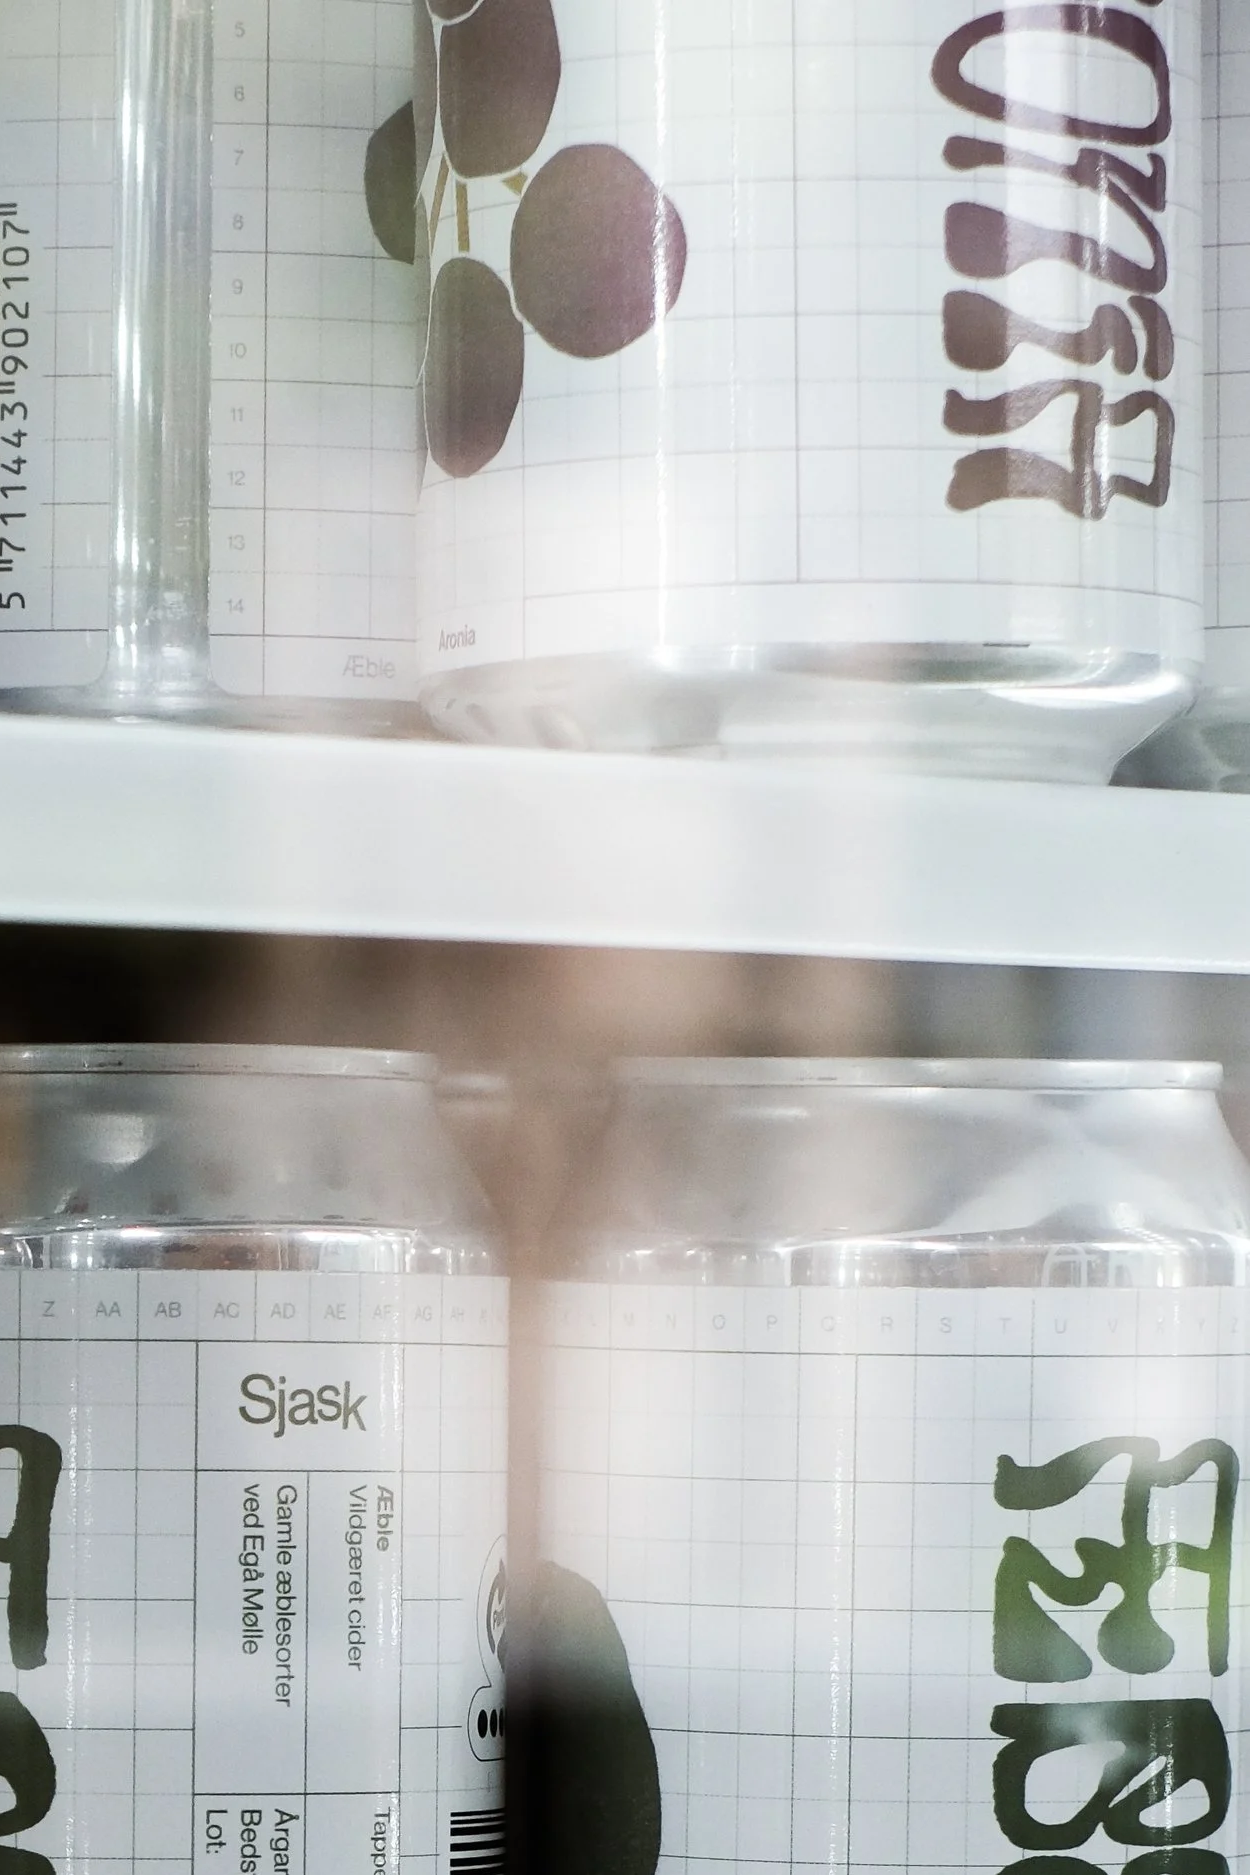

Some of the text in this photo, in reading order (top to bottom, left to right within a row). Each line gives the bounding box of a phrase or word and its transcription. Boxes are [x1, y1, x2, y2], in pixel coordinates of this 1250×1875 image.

[234, 23, 245, 39] 5
[234, 150, 244, 166] 7
[1, 220, 30, 375] 902107
[232, 279, 244, 295] 9
[230, 343, 247, 359] 10
[230, 407, 244, 422] 11
[0, 402, 28, 556] 711443
[227, 471, 245, 486] 12
[228, 535, 245, 550] 13
[227, 599, 244, 613] 14
[438, 624, 476, 652] Aronia
[343, 655, 396, 678] Æble
[43, 1301, 55, 1318] Z
[96, 1301, 121, 1318] AA
[154, 1302, 182, 1318] AB
[213, 1302, 240, 1319] AC
[270, 1303, 296, 1320] AD
[324, 1303, 347, 1320] AE
[372, 1304, 392, 1320] AF
[414, 1305, 432, 1322] AG
[712, 1313, 726, 1331] O
[766, 1314, 778, 1331] P
[881, 1317, 893, 1332] R
[939, 1317, 953, 1334] S
[1000, 1317, 1012, 1334] T
[1054, 1317, 1068, 1334] U
[1108, 1317, 1119, 1334] V
[238, 1373, 368, 1438] Sjask
[376, 1484, 395, 1552] Æble
[239, 1483, 266, 1655] ved Egå Mølle
[345, 1484, 368, 1672] Vildgæret cider
[275, 1484, 299, 1708] Gamle æblesorter
[205, 1809, 228, 1855] Lot:
